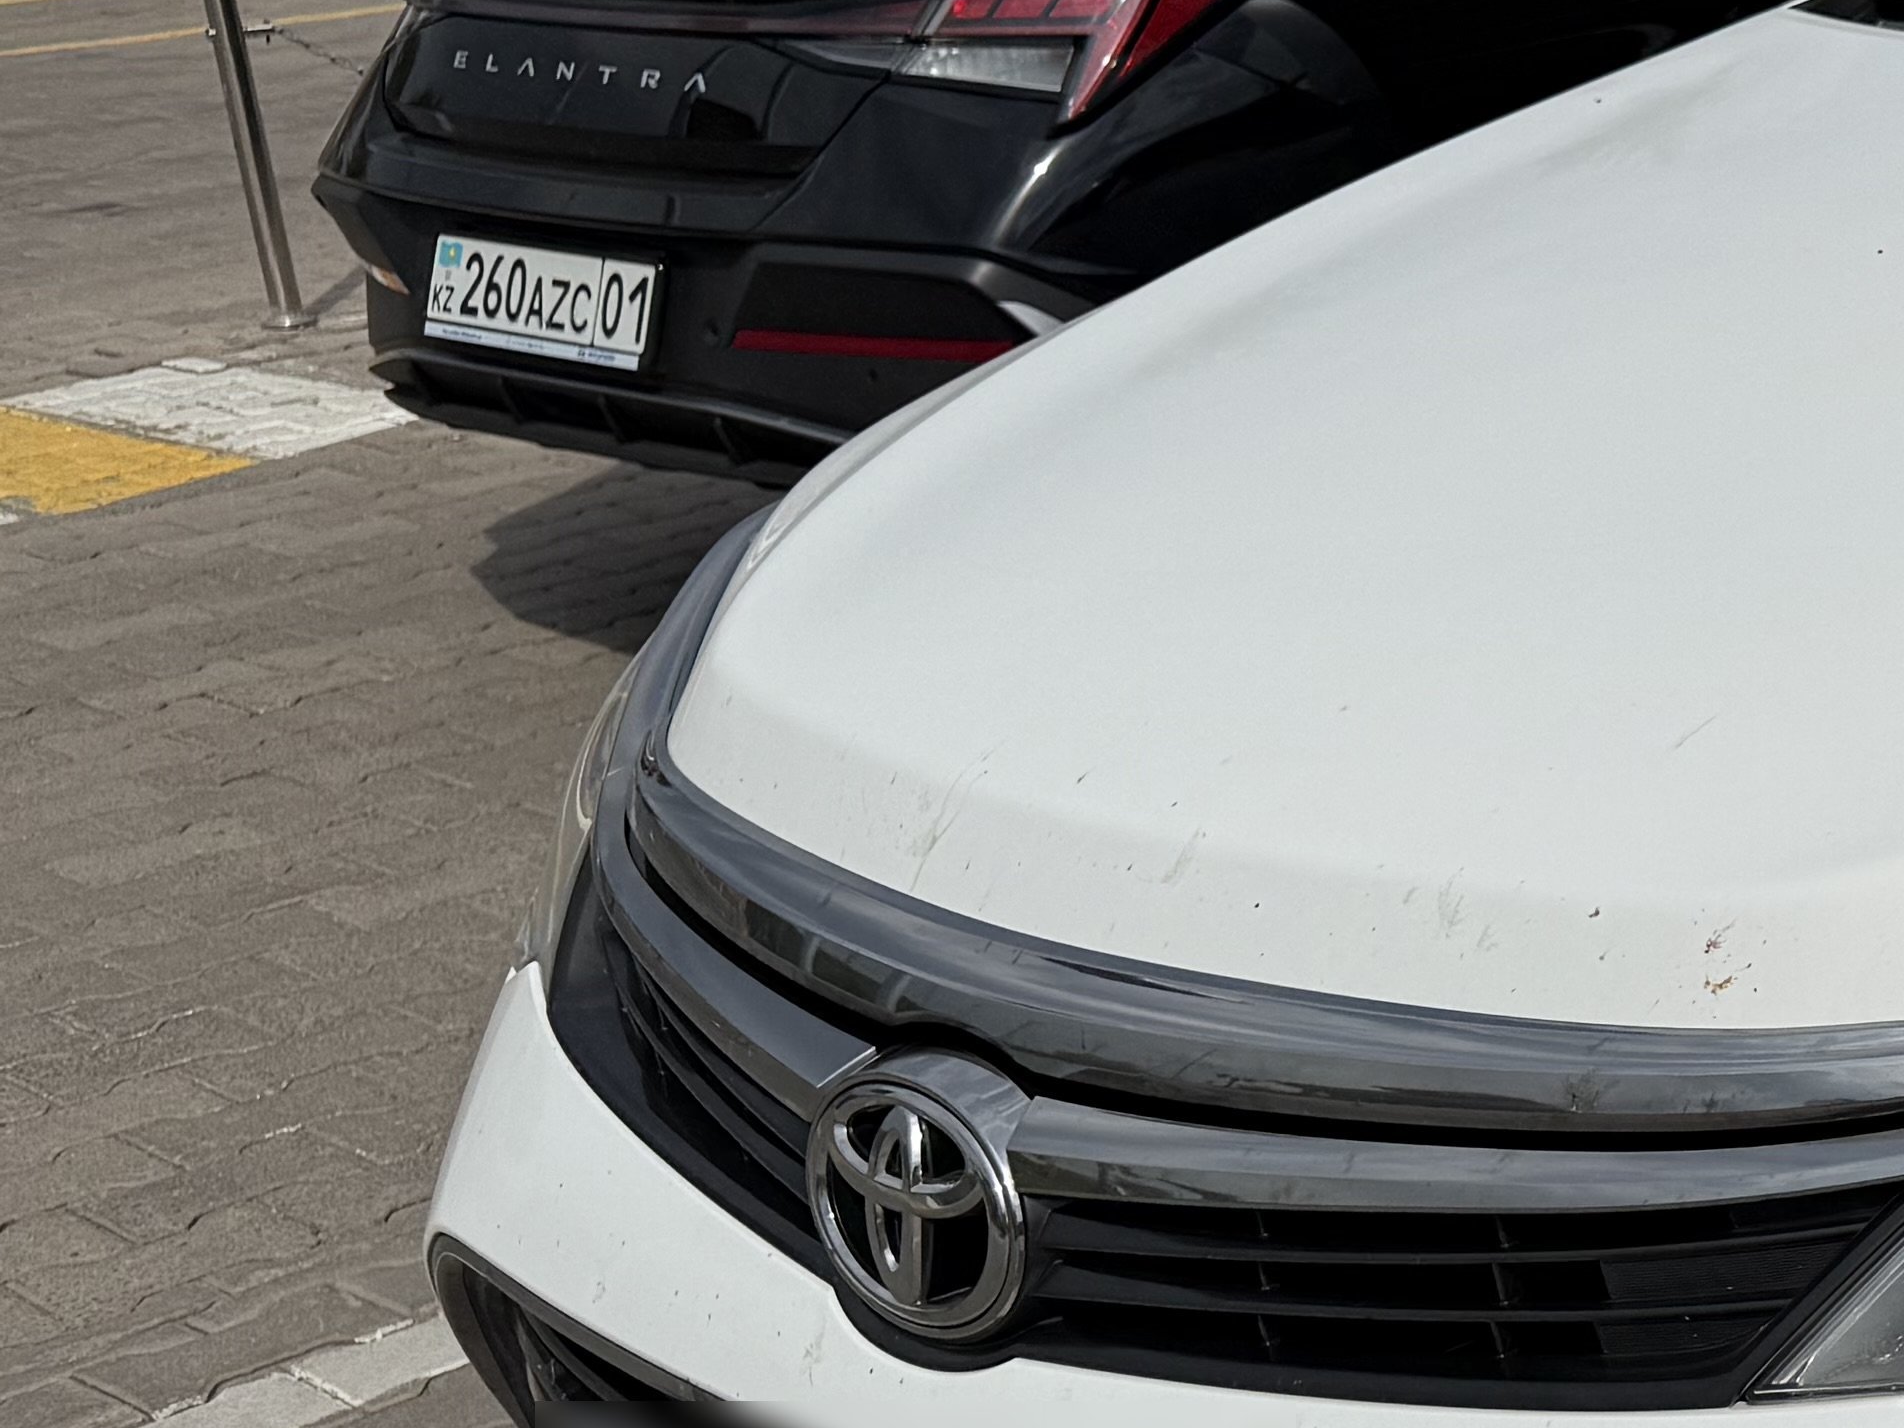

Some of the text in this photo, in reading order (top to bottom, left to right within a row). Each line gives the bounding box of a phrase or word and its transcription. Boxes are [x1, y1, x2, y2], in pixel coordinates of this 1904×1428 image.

[452, 49, 707, 94] ELANTRA
[431, 283, 455, 314] KZ
[600, 271, 650, 347] 01
